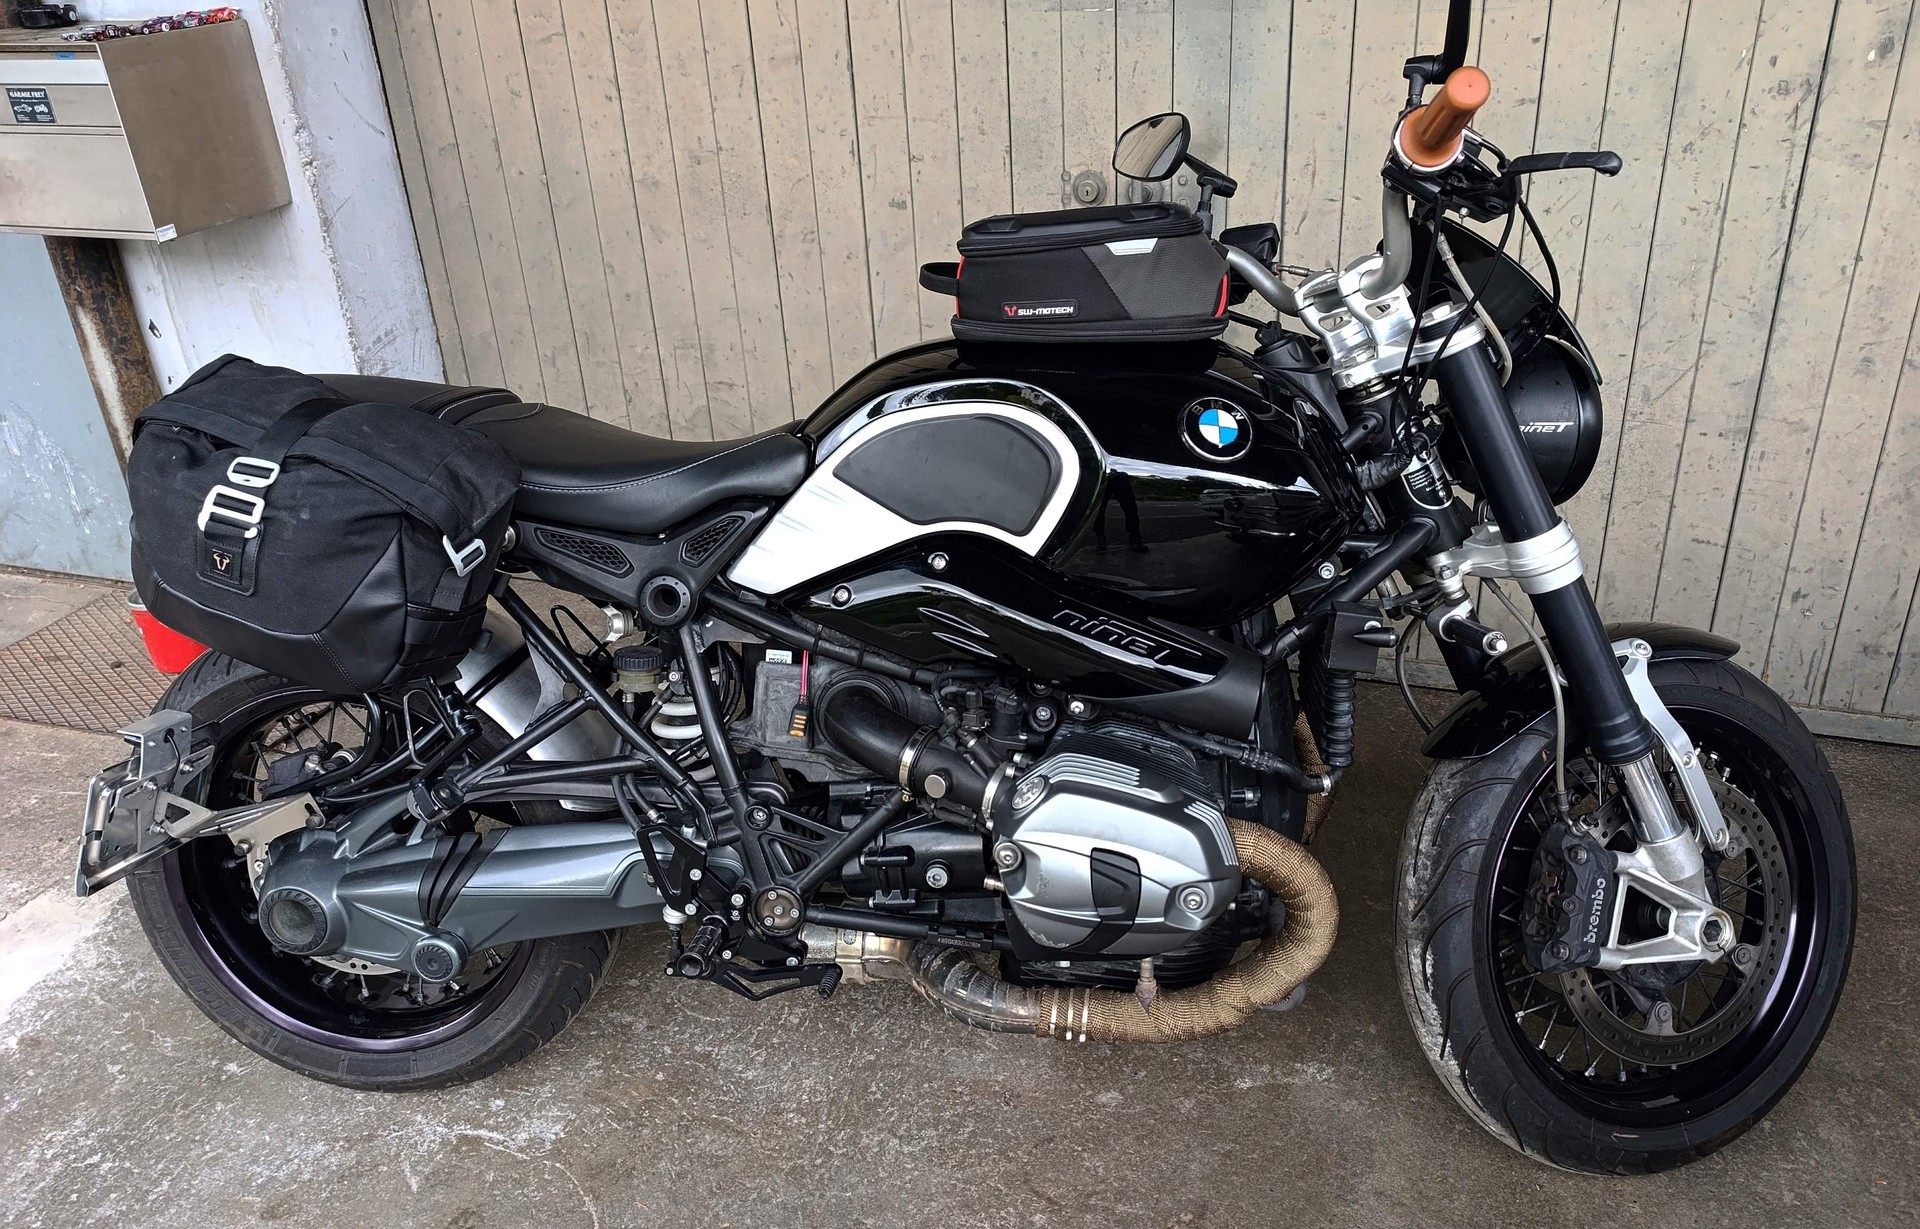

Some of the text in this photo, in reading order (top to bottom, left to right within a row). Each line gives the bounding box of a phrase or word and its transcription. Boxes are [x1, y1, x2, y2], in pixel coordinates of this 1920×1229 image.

[1017, 306, 1075, 316] SW-MOTECH
[1190, 400, 1245, 420] BMW
[1583, 877, 1607, 944] brembo
